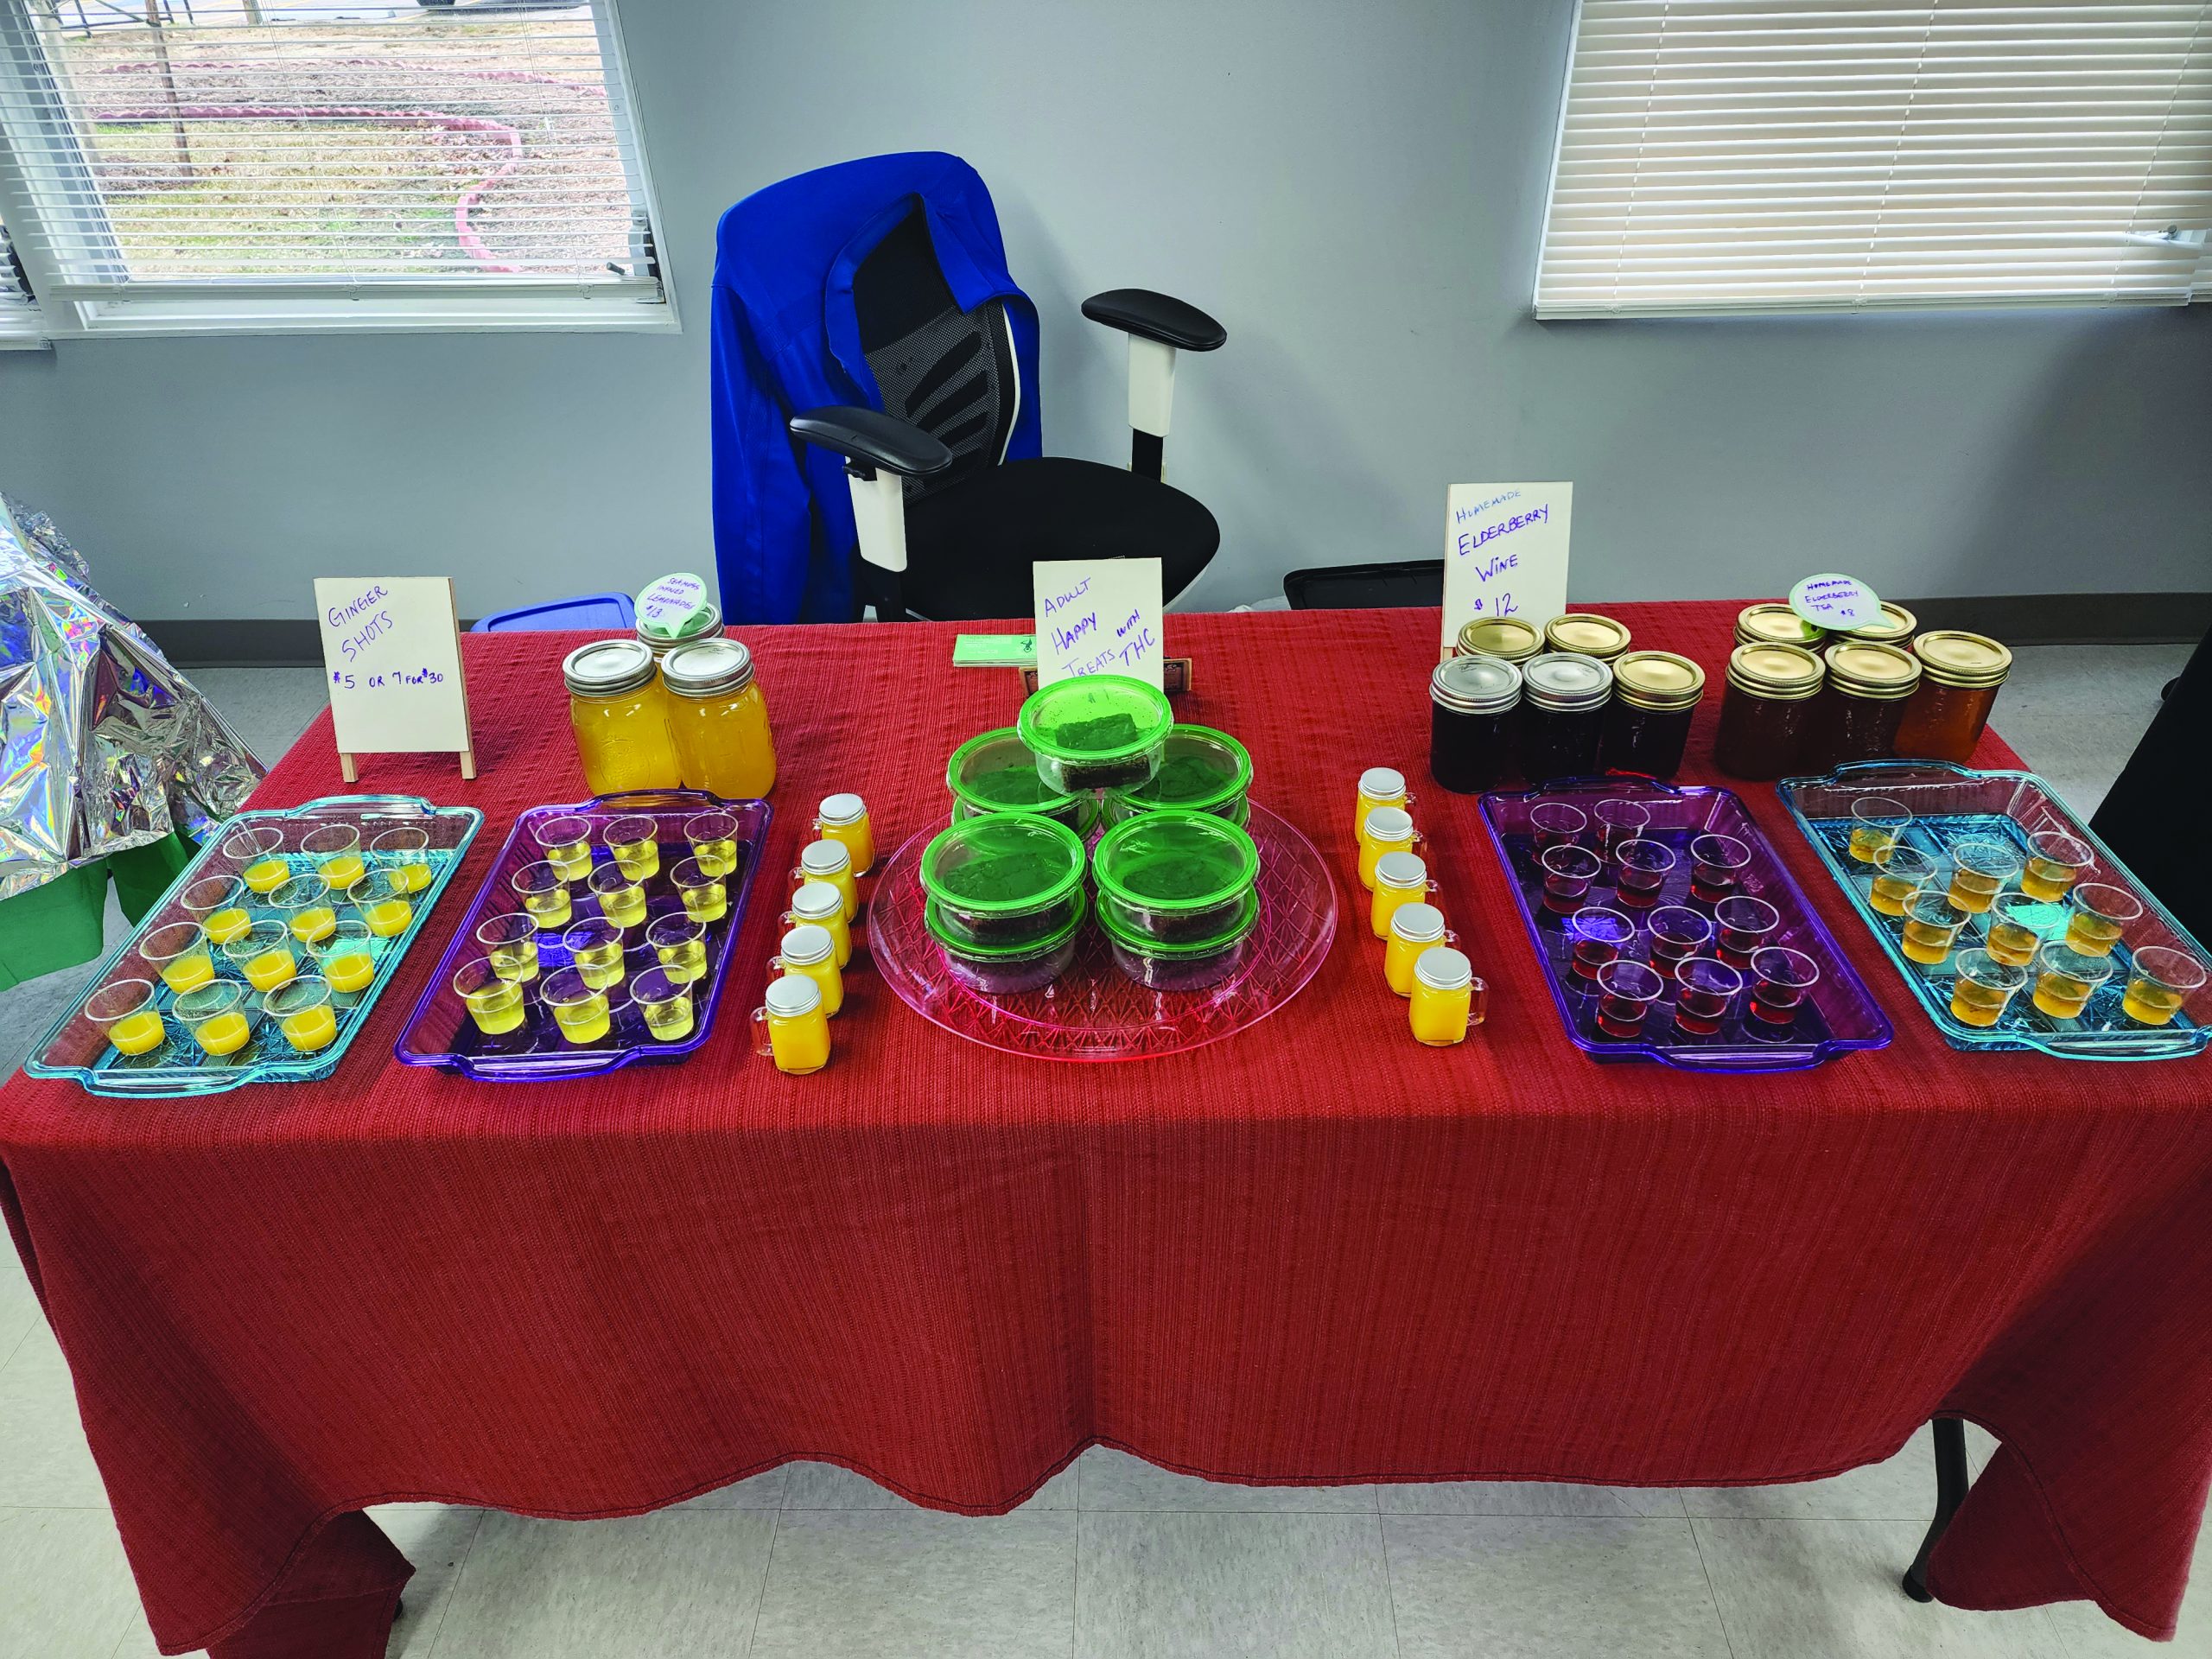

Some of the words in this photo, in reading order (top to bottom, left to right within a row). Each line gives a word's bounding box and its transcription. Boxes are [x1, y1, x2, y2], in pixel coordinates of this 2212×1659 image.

[1459, 503, 1548, 556] ELDERBERRY
[328, 586, 388, 627] GINGER
[1045, 577, 1091, 618] ADULT
[1810, 603, 1834, 612] TEA
[341, 610, 393, 662] SHOTS
[1051, 612, 1096, 655] HAPPY
[1119, 628, 1155, 666] THC
[369, 676, 385, 688] OR
[392, 671, 402, 684] 7
[1061, 649, 1116, 677] TREATS
